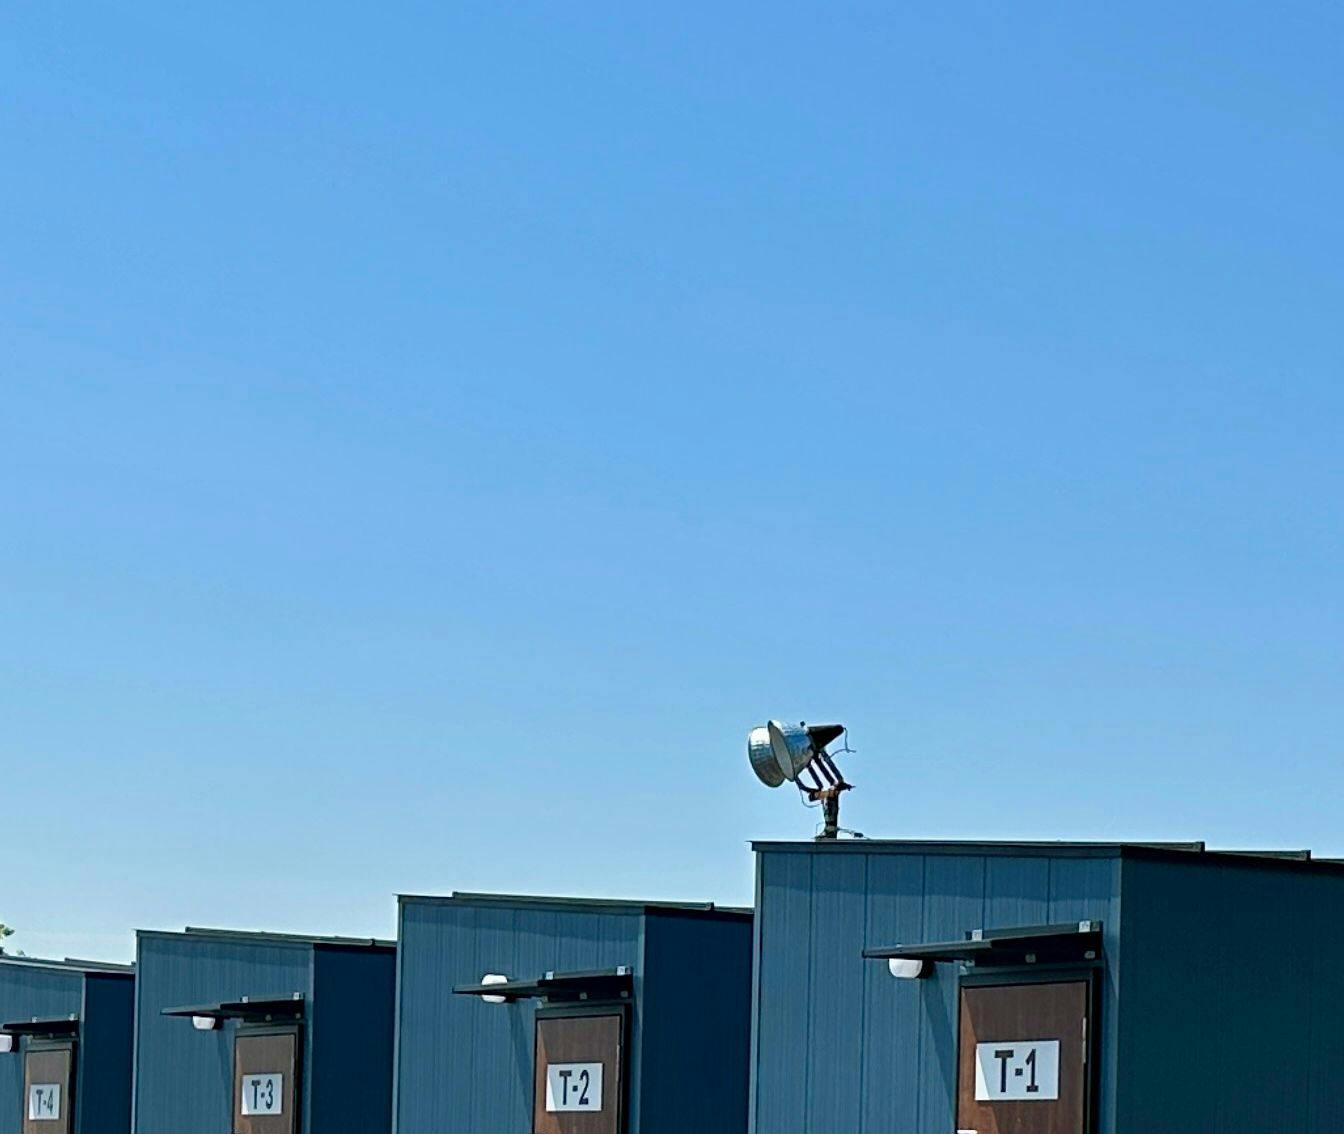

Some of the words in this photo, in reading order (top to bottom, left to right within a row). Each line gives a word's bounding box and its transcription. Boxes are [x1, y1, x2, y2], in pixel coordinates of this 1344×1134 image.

[558, 1069, 590, 1106] T-2
[994, 1048, 1039, 1093] T-1
[35, 1088, 54, 1116] T-4
[250, 1078, 274, 1110] T-3
